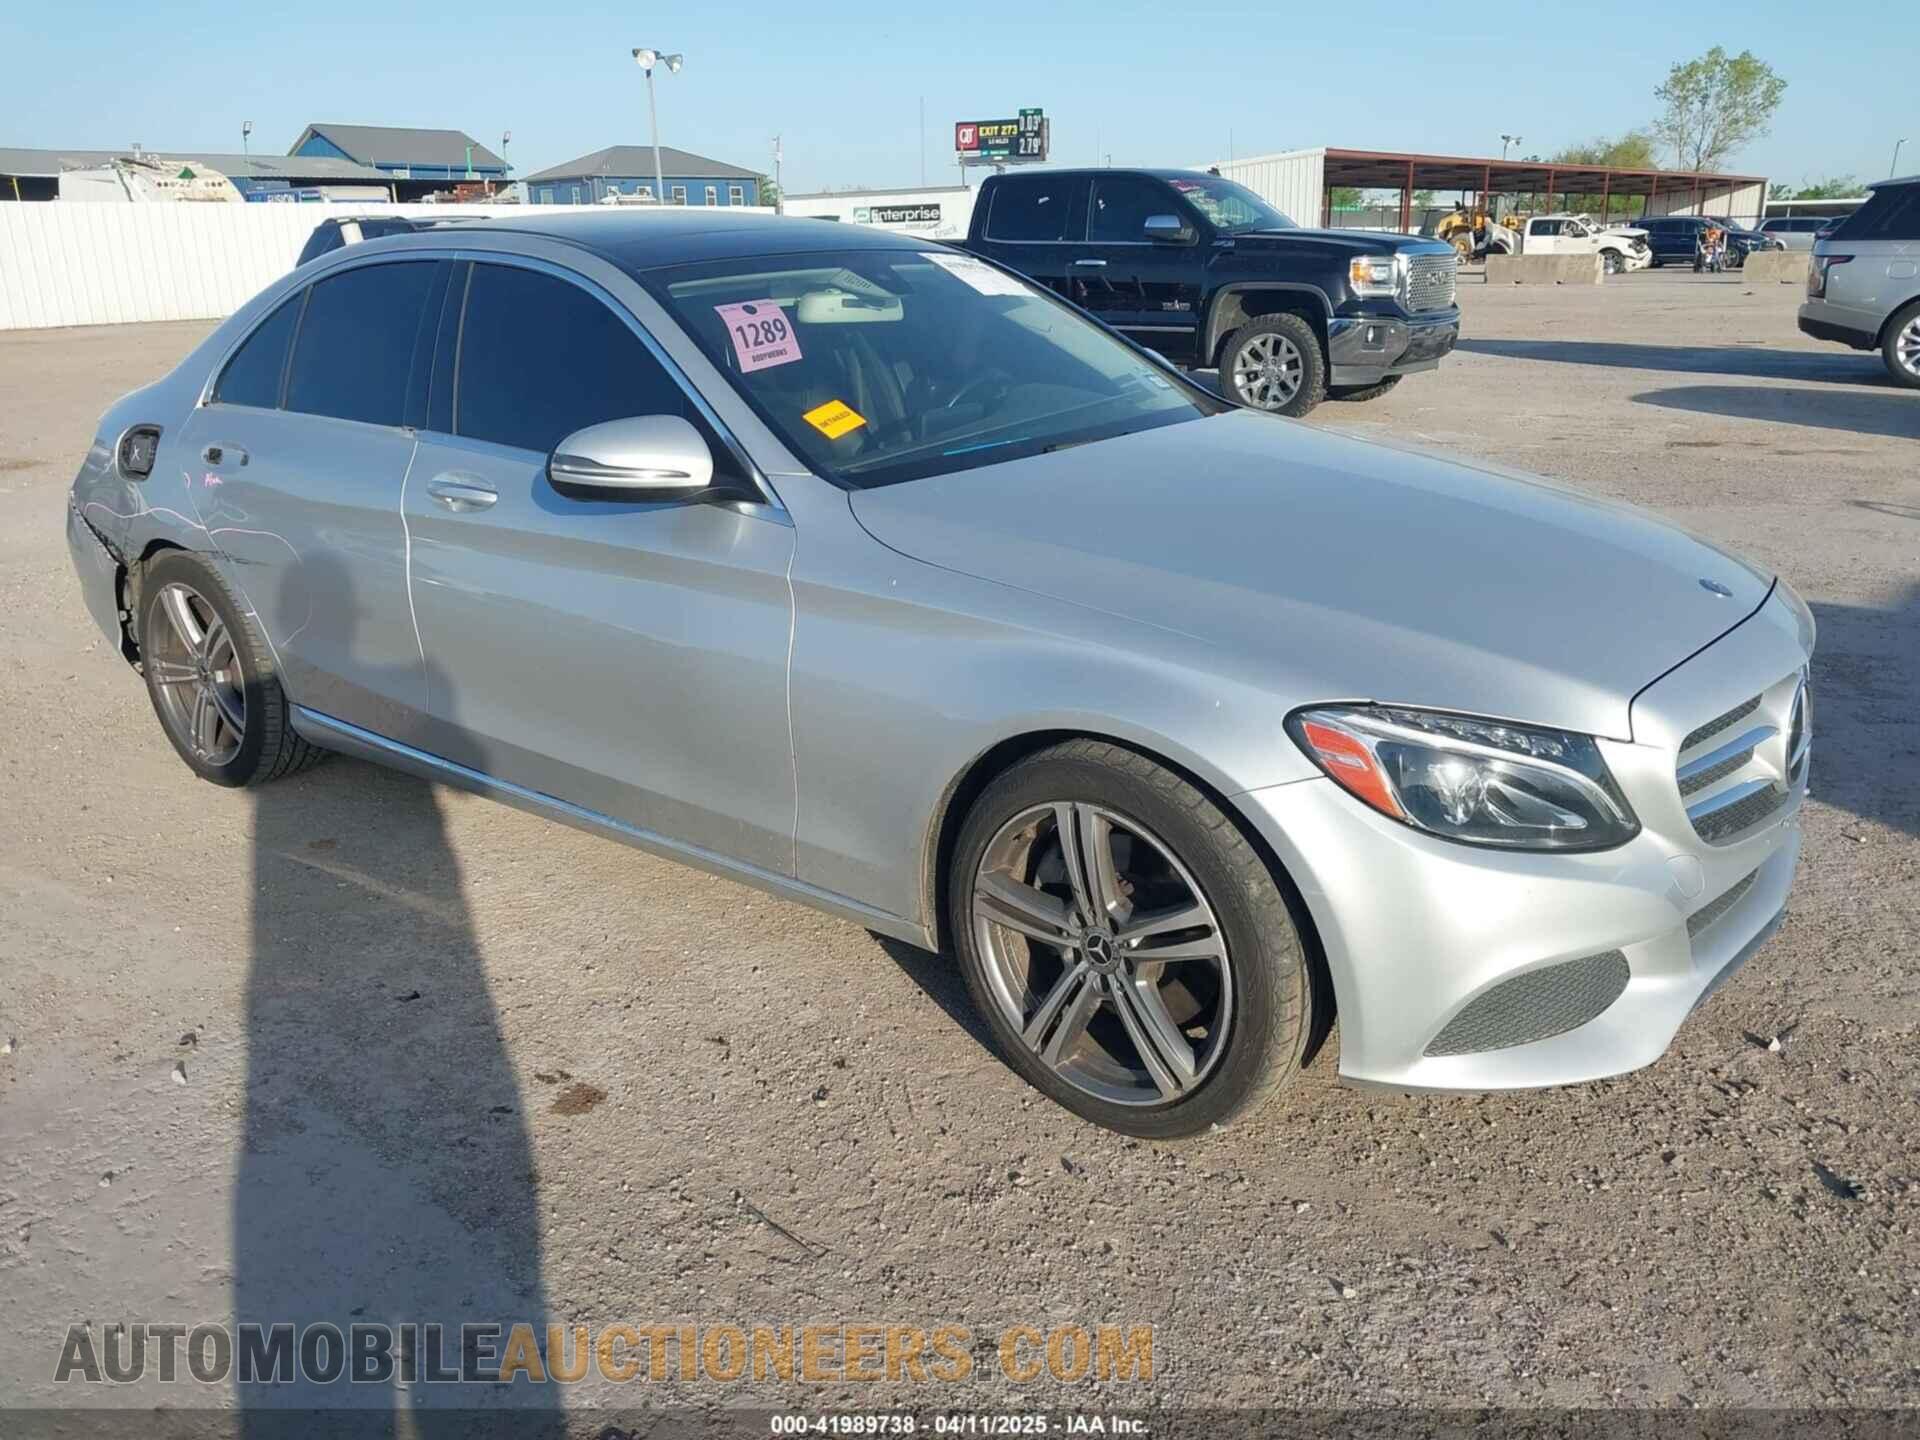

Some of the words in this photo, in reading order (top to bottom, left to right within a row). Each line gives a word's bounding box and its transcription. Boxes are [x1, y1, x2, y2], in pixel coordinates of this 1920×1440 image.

[979, 126, 999, 136] EXIT
[1001, 124, 1018, 135] 273
[871, 206, 940, 223] Enterprise
[735, 318, 787, 349] 1289
